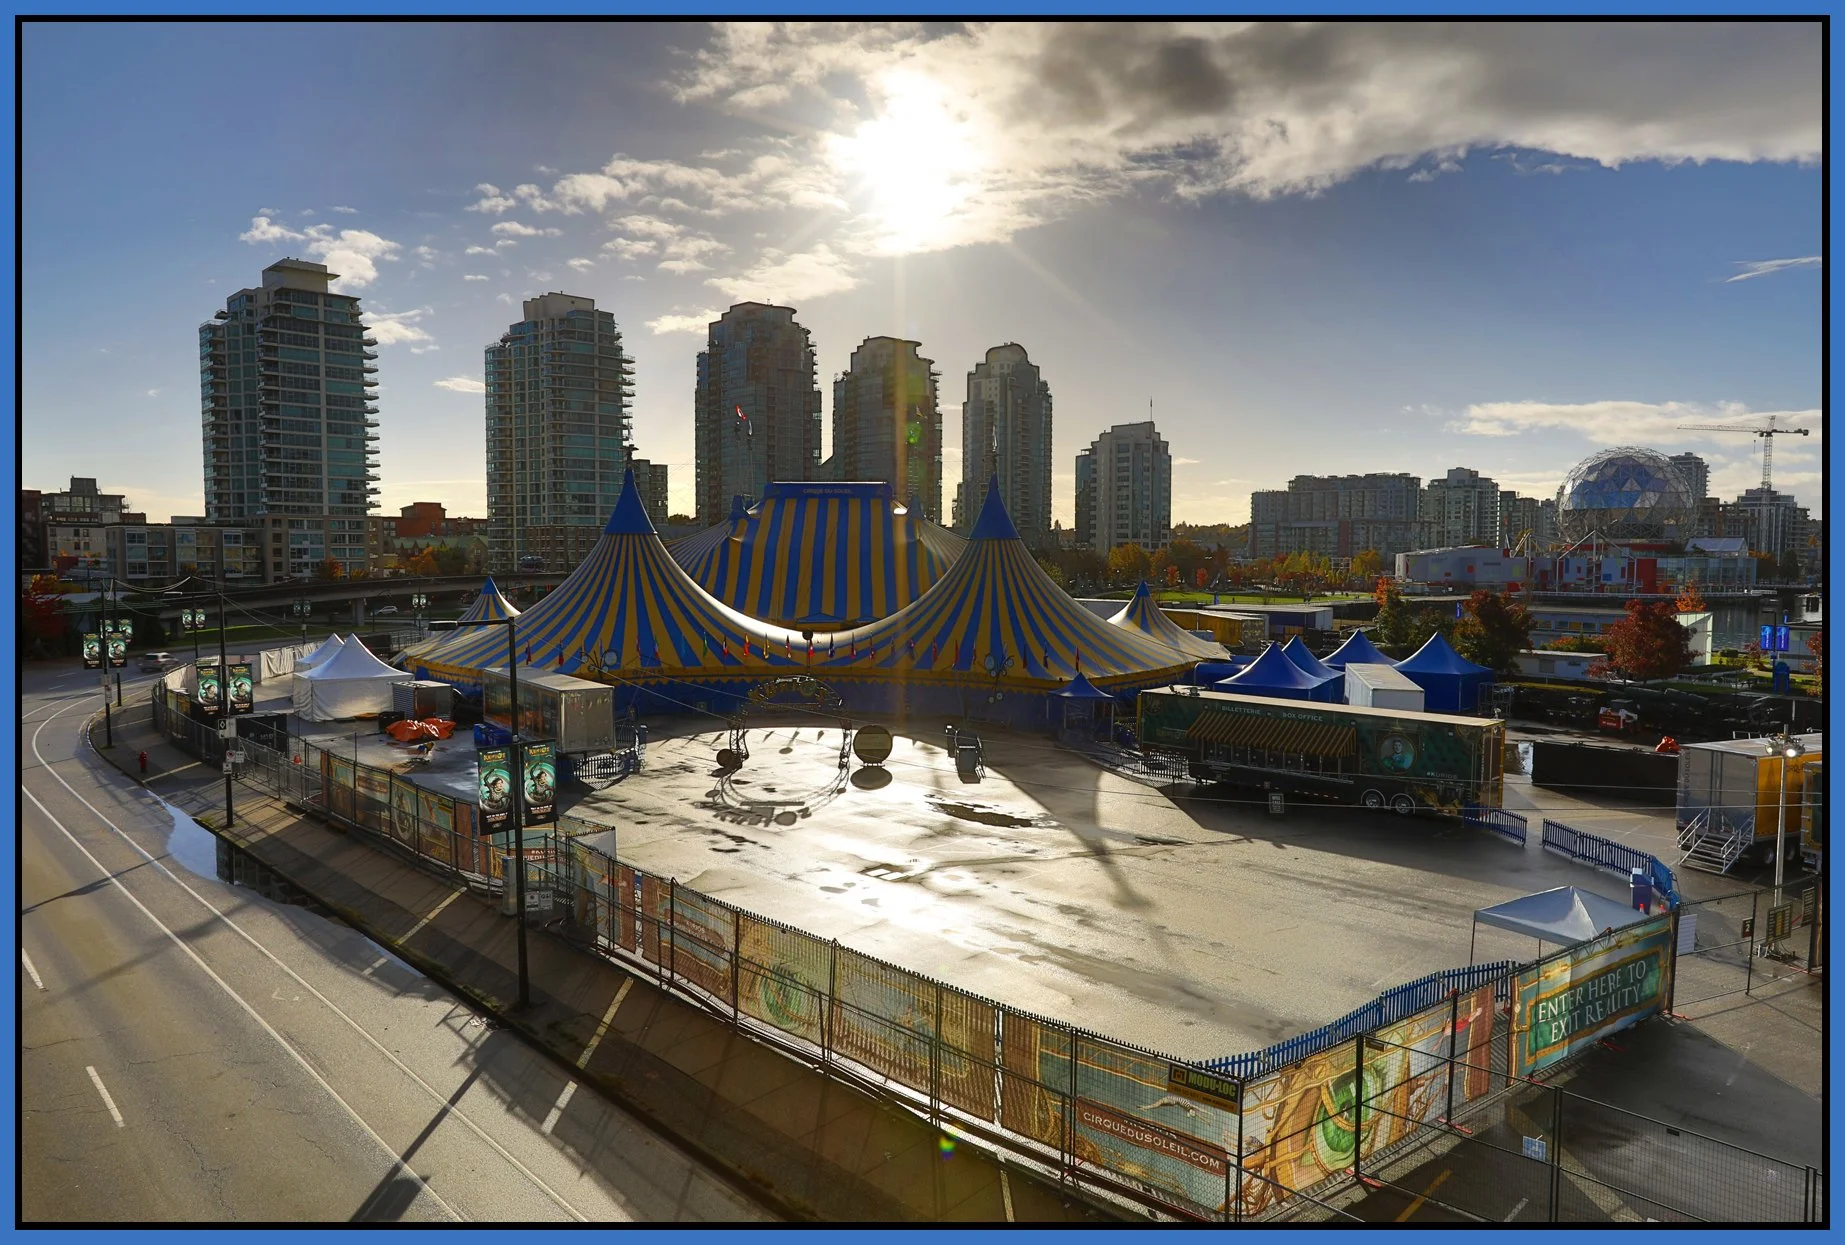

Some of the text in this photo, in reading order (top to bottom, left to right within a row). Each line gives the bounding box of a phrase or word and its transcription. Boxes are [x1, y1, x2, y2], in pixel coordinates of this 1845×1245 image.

[1221, 705, 1261, 715] BILLETTERIE
[1297, 713, 1322, 721] OFFICE
[1538, 960, 1647, 1023] ENTER HERE TO
[1551, 984, 1641, 1043] EXIT REALITY
[1189, 1071, 1236, 1096] MODU-LOC
[1083, 1112, 1220, 1168] CIRQUEDUSOLEIL.COM
